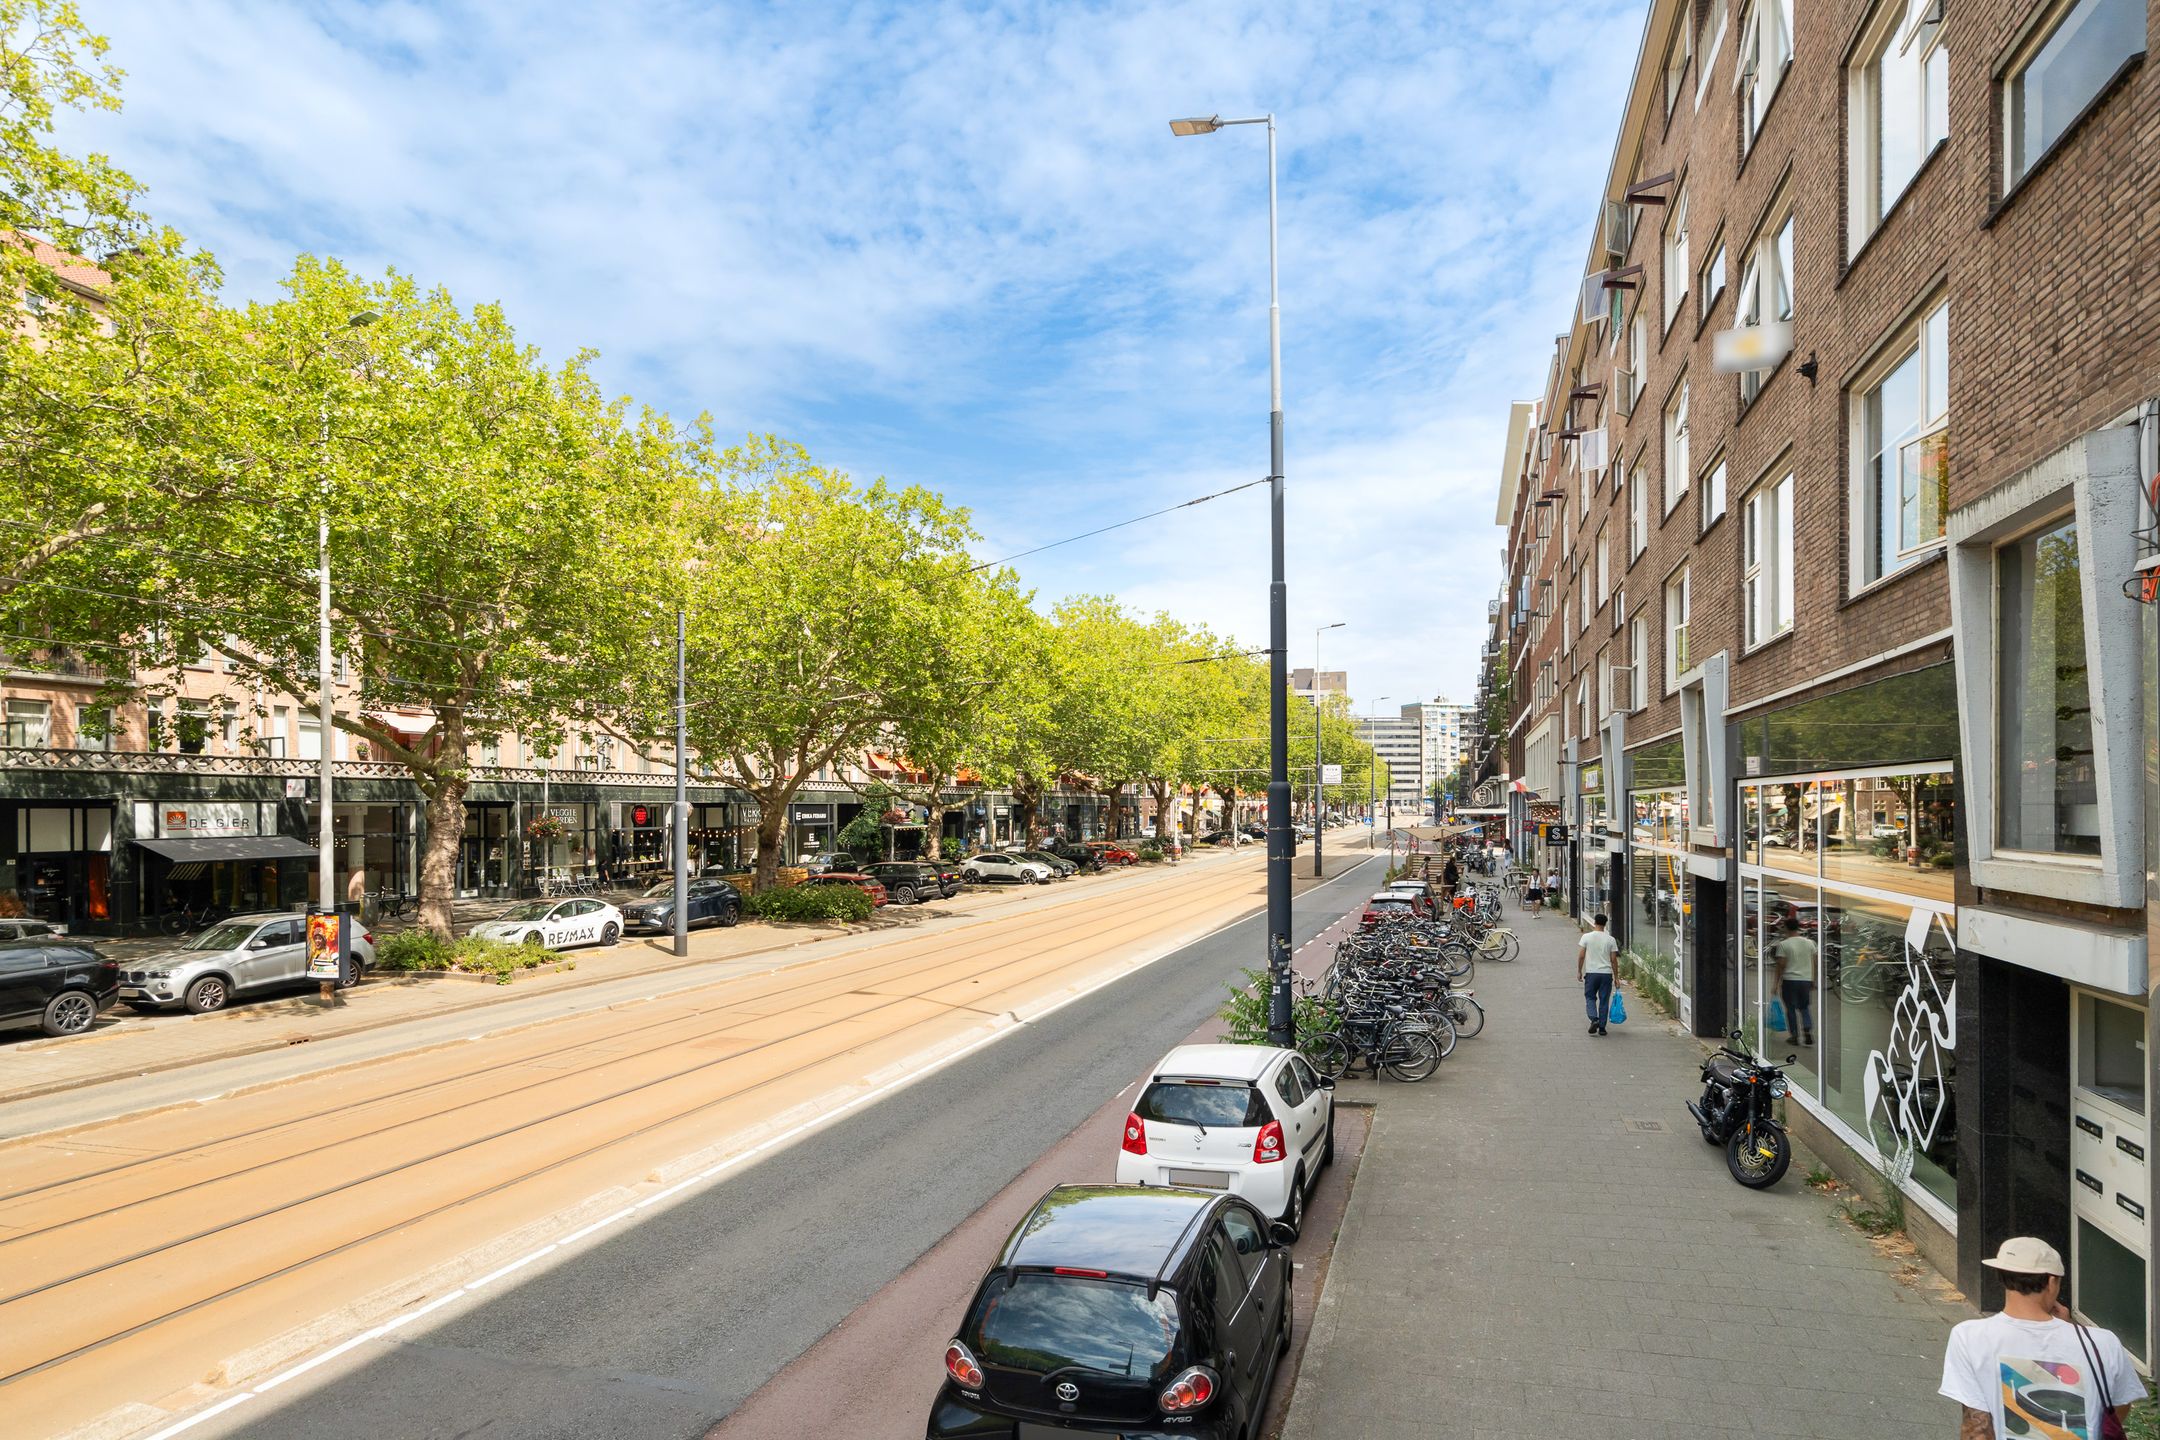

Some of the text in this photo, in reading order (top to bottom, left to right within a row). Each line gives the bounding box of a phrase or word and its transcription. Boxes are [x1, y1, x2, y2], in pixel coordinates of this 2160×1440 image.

[550, 808, 577, 817] VEGGIE
[189, 818, 250, 828] DE GIER
[548, 927, 594, 945] RE/MAX
